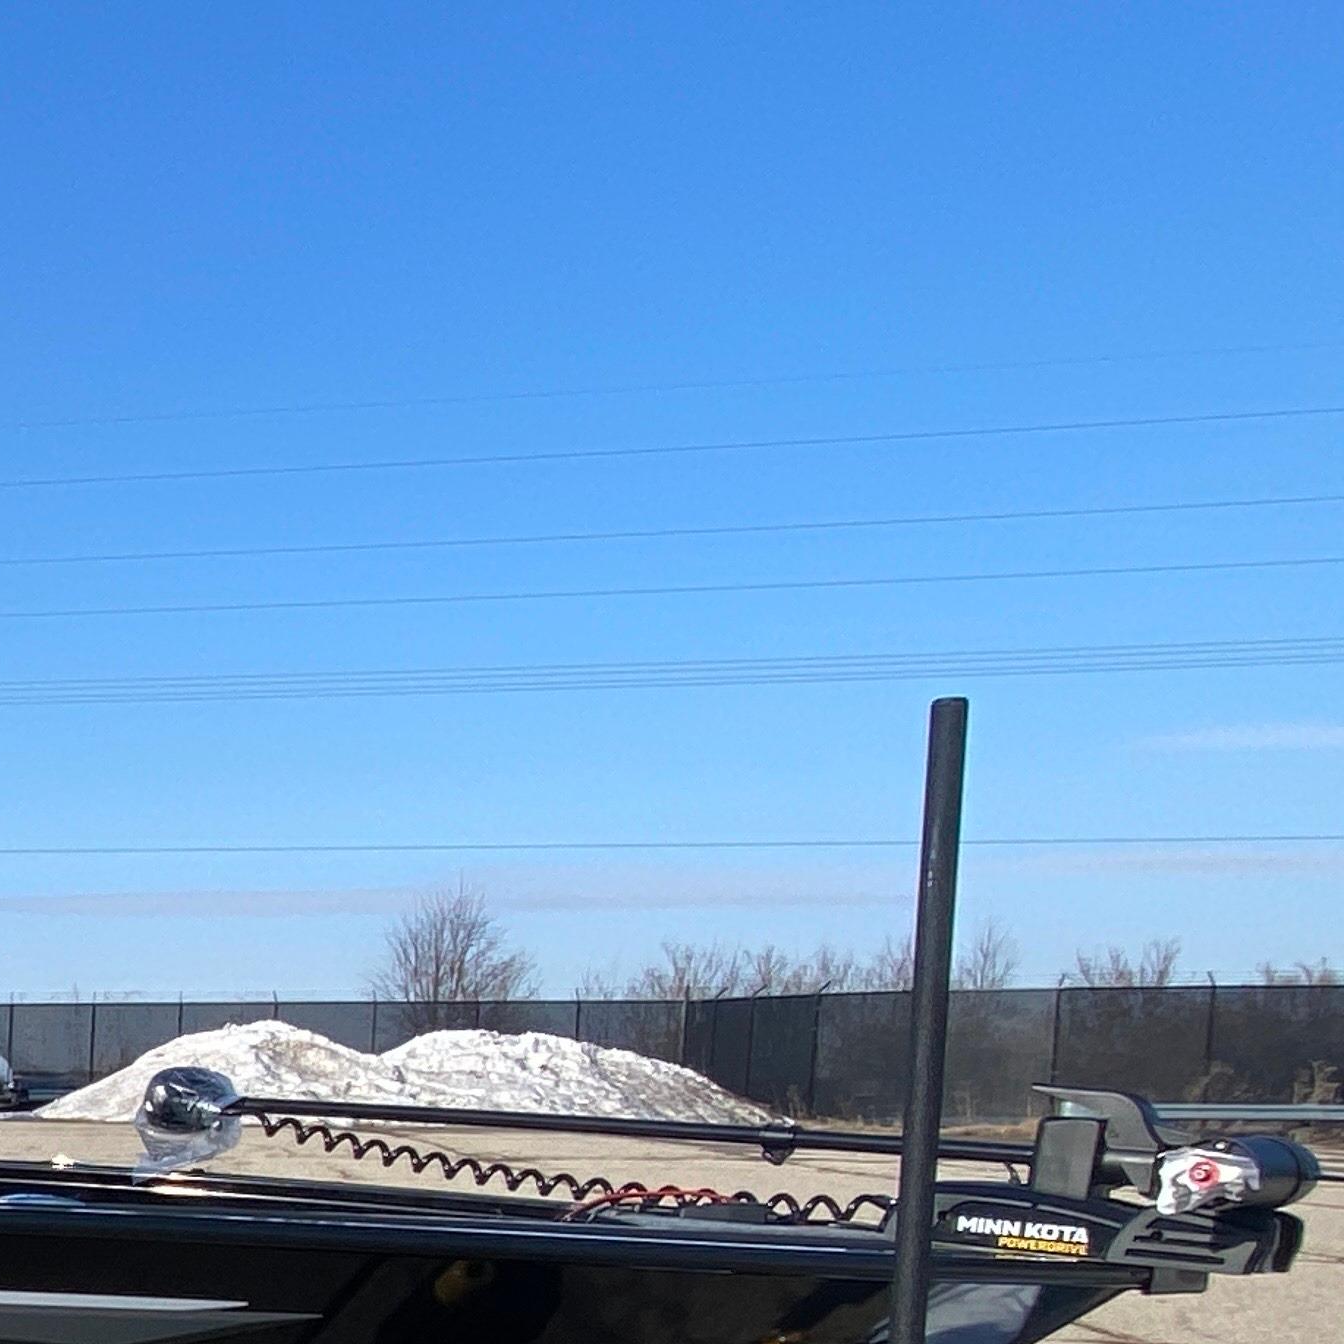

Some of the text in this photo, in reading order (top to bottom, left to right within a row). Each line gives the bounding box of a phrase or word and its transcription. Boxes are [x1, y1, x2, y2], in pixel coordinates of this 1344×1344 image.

[957, 1215, 1089, 1244] MINN KOTA
[997, 1235, 1089, 1256] POWERDRIVE
